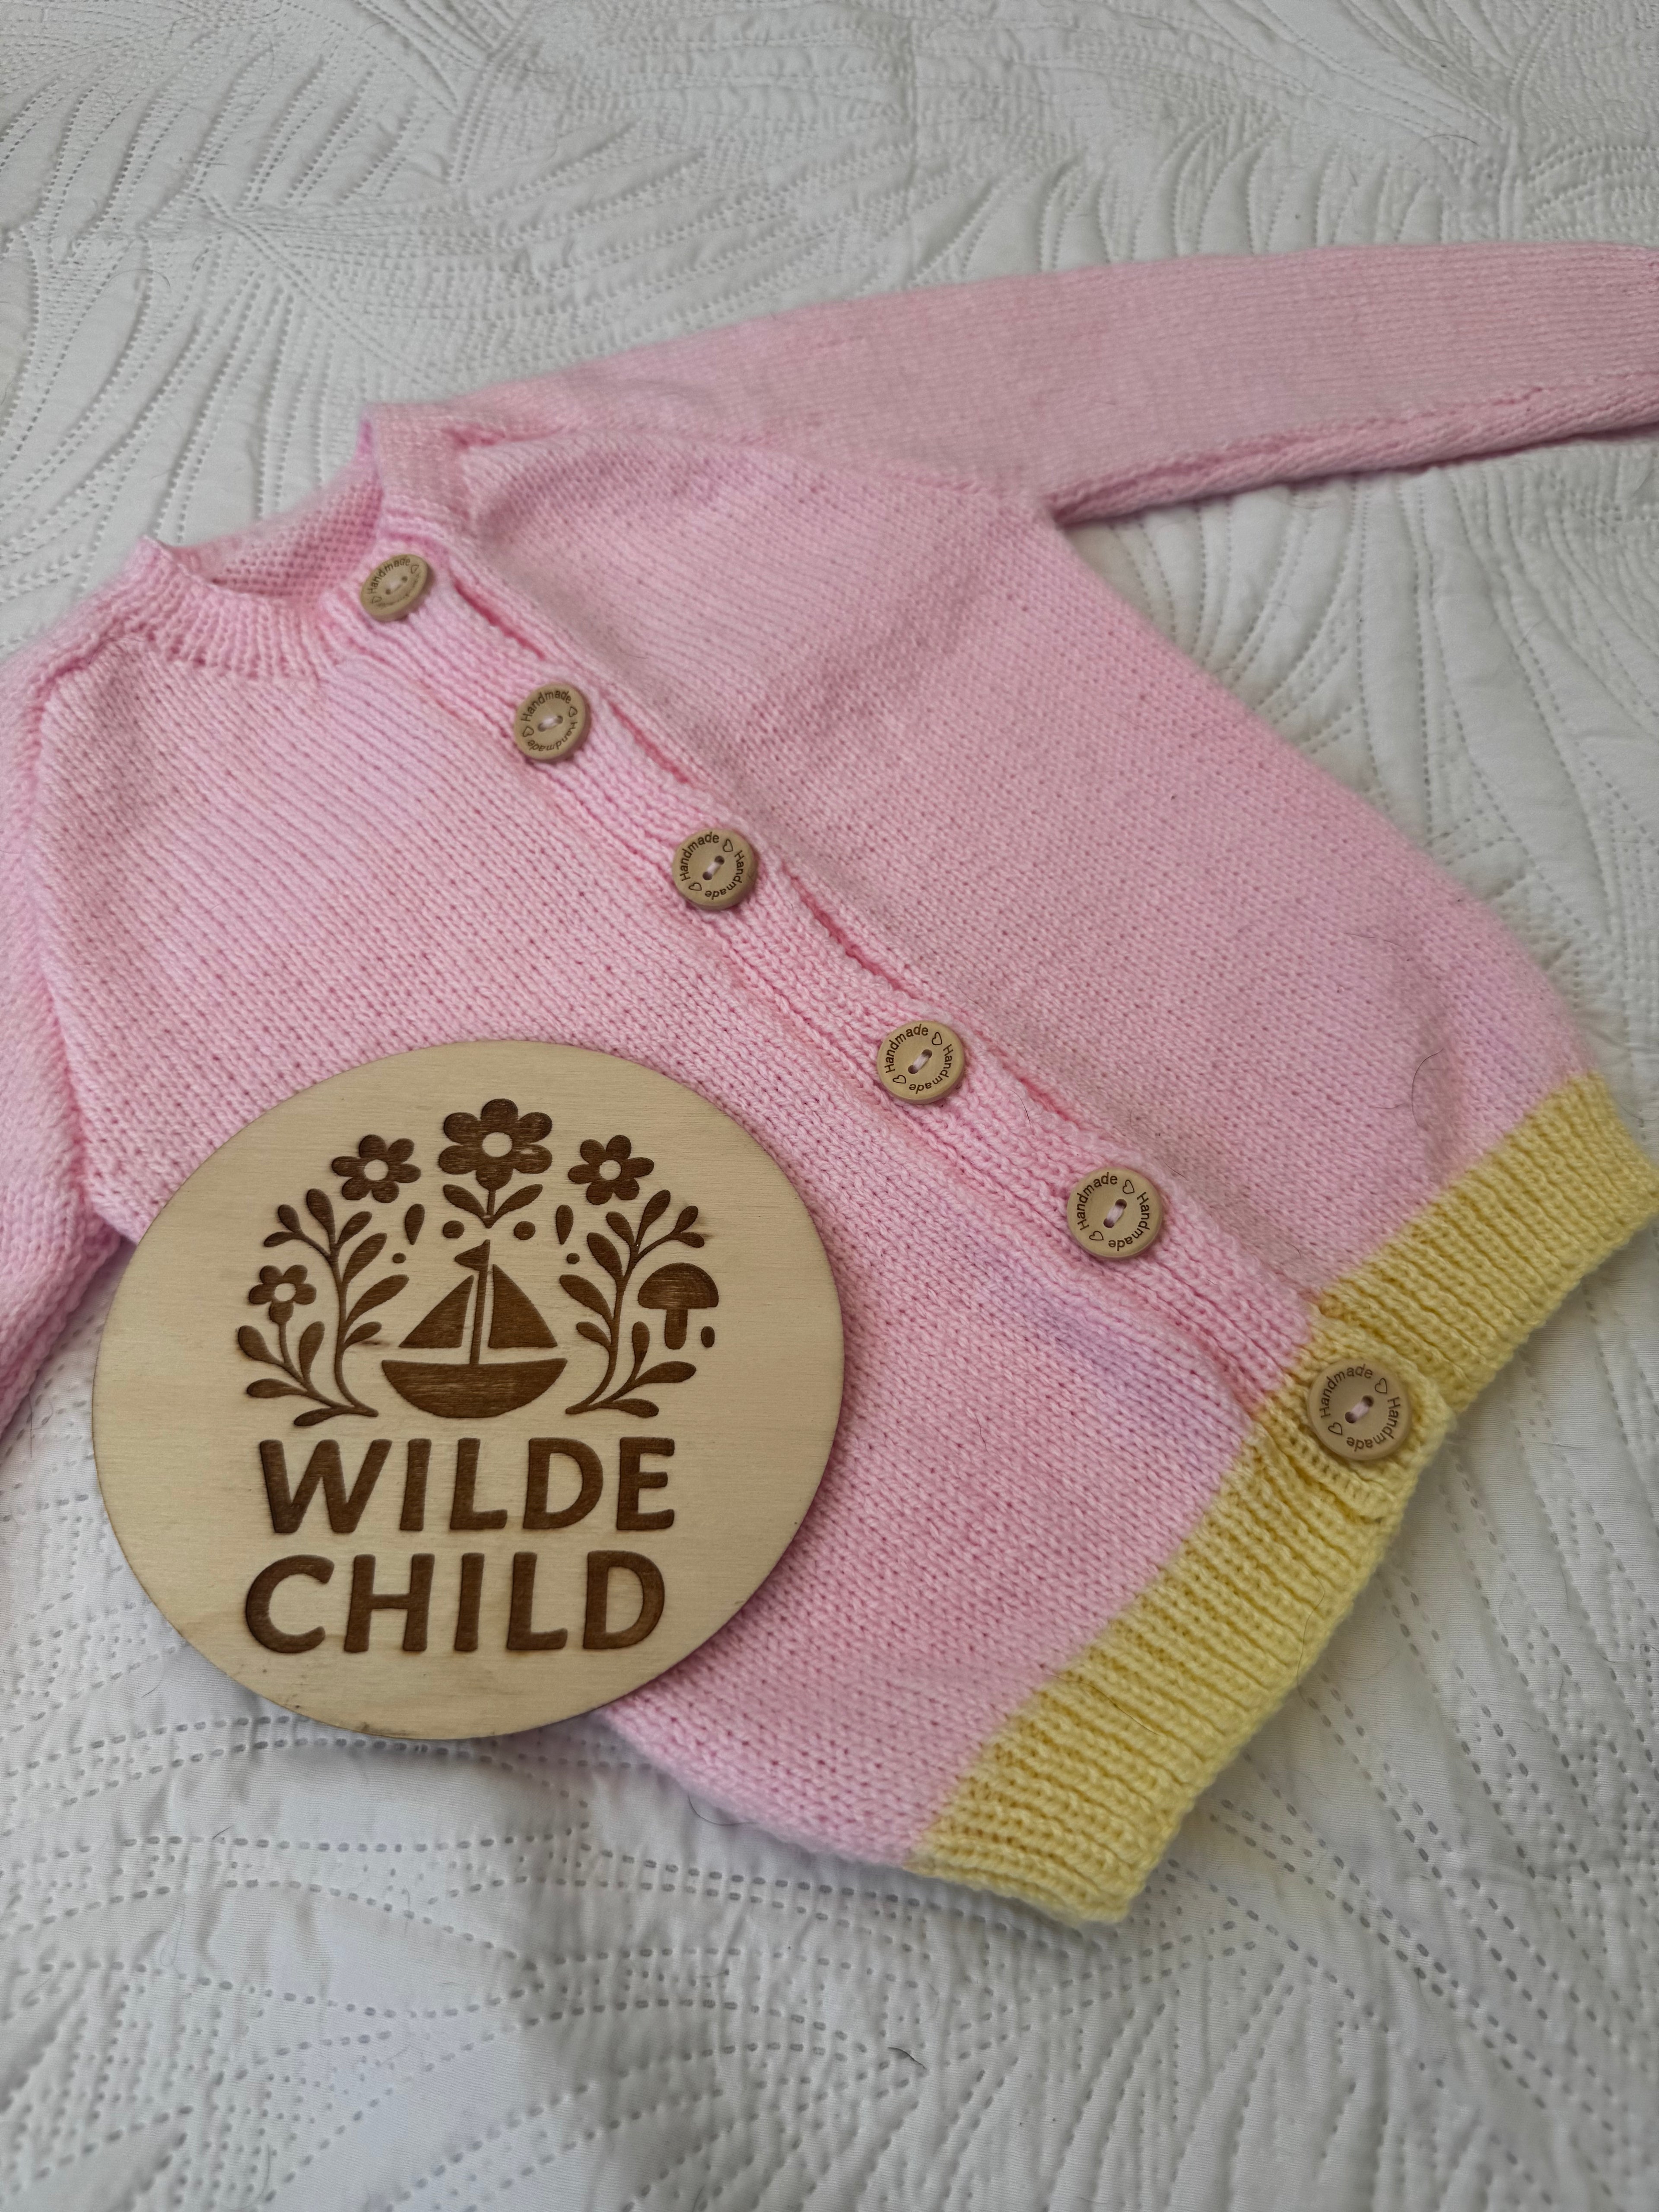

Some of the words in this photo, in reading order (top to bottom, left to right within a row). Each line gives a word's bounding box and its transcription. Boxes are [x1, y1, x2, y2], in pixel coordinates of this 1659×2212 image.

[367, 558, 410, 594] Handmade
[520, 690, 572, 722] Handmade
[527, 721, 577, 752] Handmade
[680, 832, 719, 881] Handmade
[704, 850, 744, 899] Handmade
[885, 1023, 929, 1074] Handmade
[909, 1044, 953, 1093] Handmade
[1077, 1172, 1118, 1231] Handmade
[1108, 1192, 1150, 1251] Handmade
[1320, 1363, 1373, 1417] Handmade
[1346, 1396, 1402, 1452] Handmade
[258, 1437, 676, 1534] WILDE
[245, 1551, 665, 1654] CHILD
